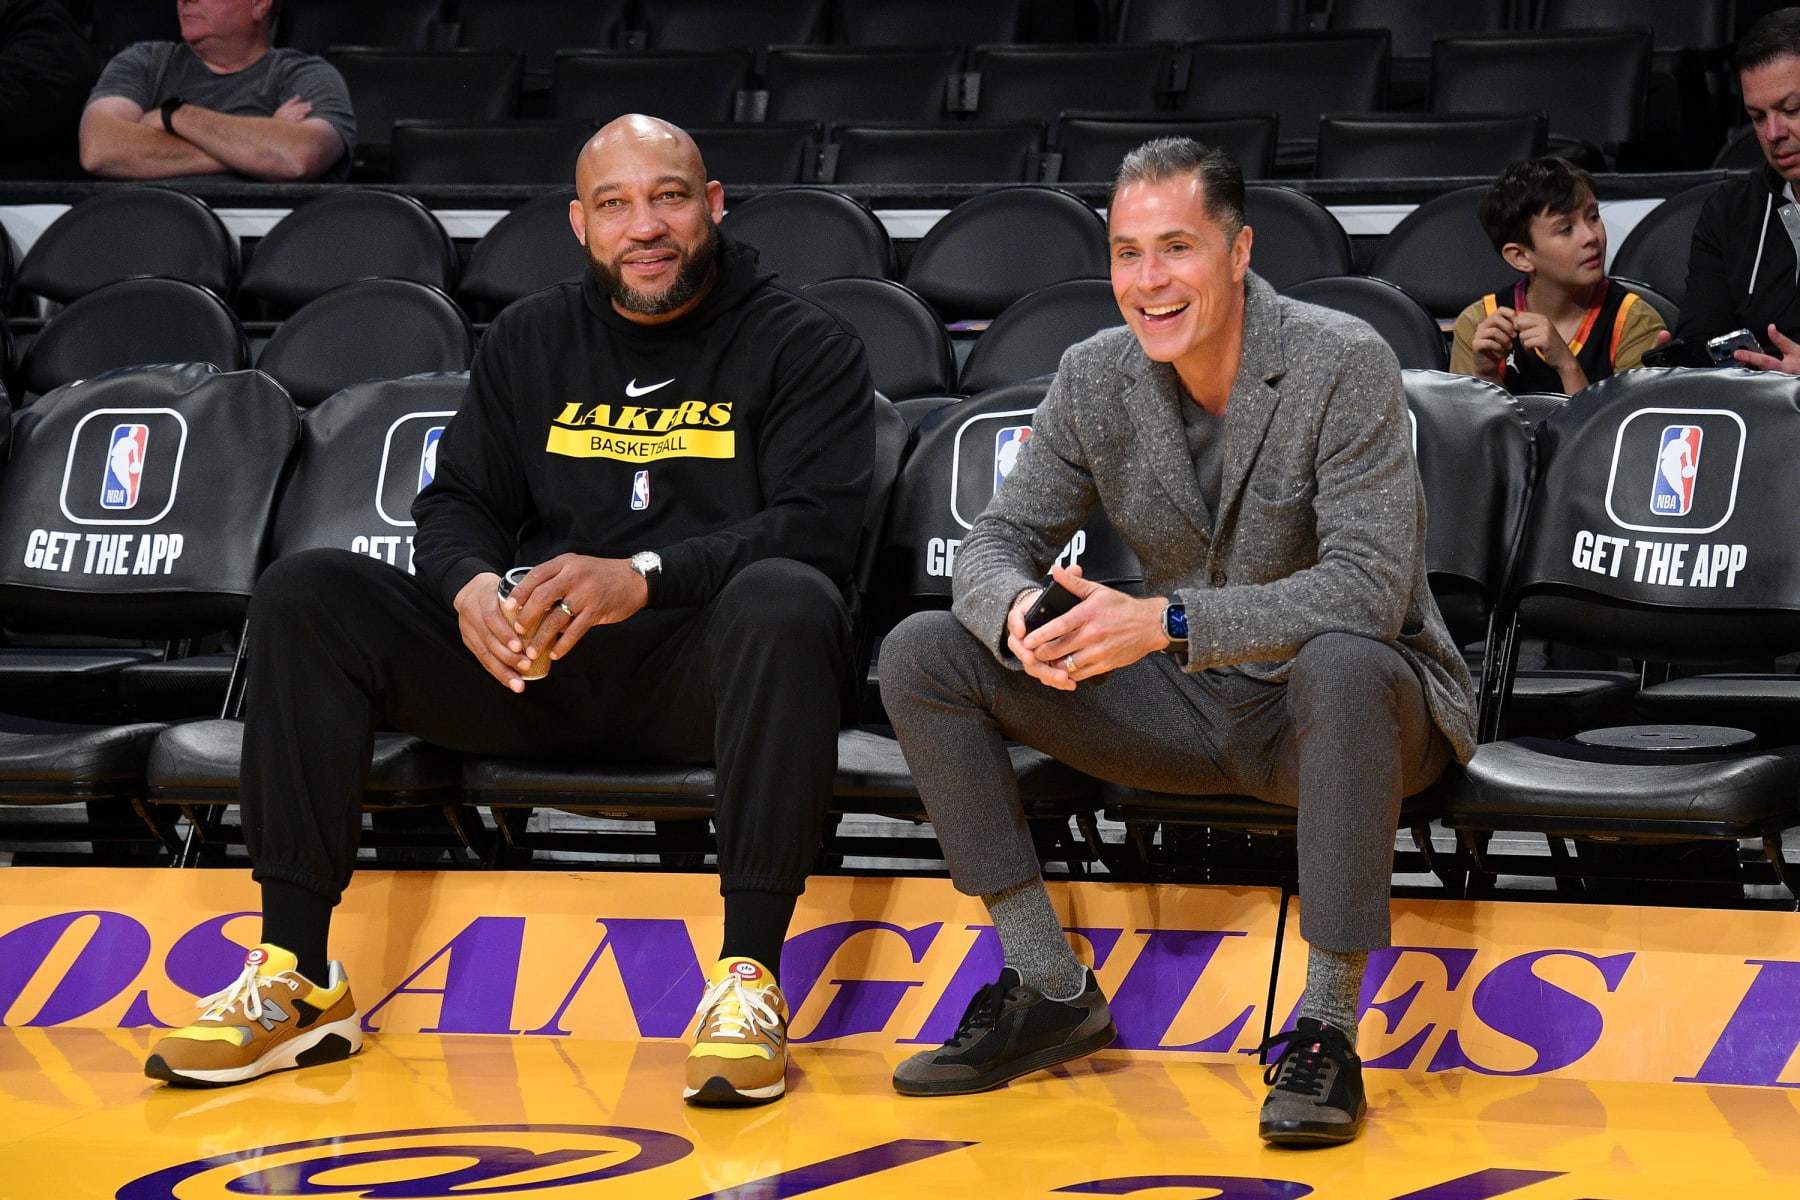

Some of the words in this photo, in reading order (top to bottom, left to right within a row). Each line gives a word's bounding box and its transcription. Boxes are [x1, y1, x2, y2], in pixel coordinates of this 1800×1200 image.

[553, 401, 733, 432] LAKERS
[590, 435, 687, 457] BASKETBALL
[106, 489, 125, 504] NBA
[1656, 494, 1677, 510] NBA
[24, 529, 82, 572] GET
[83, 534, 134, 575] THE
[132, 534, 184, 575] APP
[1571, 530, 1630, 578] GET
[1633, 540, 1689, 587] THE
[1689, 544, 1748, 588] APP
